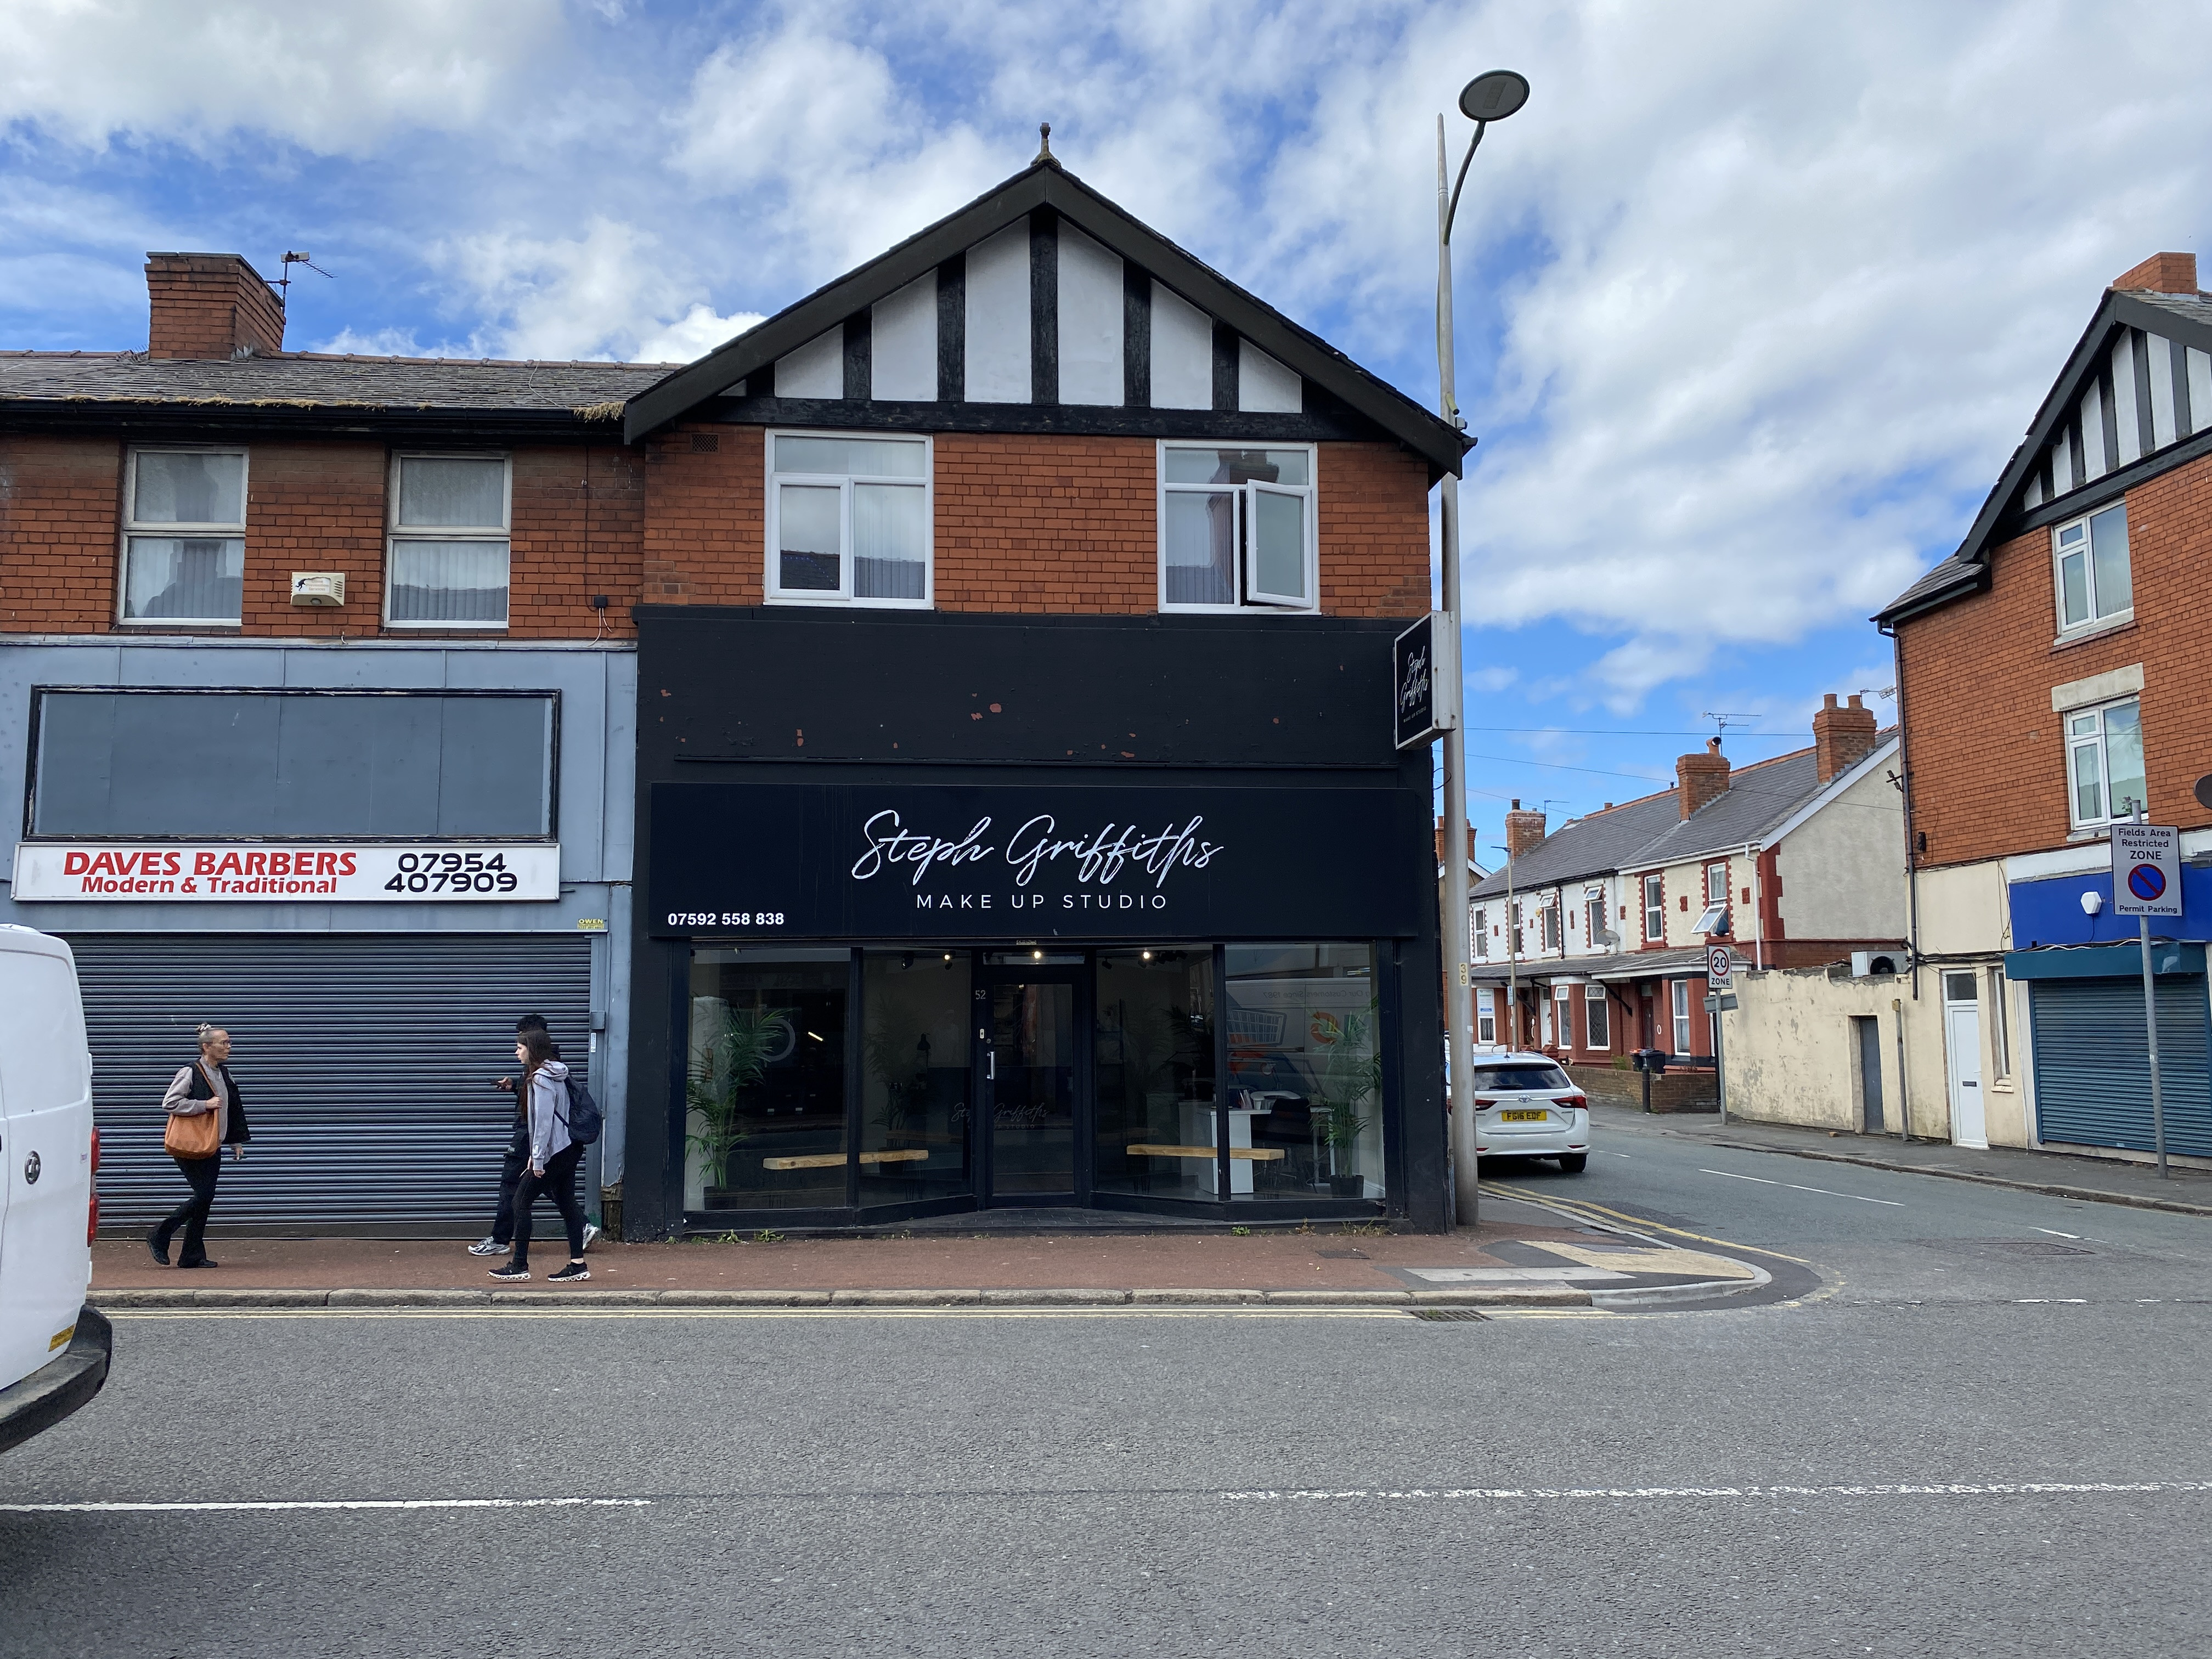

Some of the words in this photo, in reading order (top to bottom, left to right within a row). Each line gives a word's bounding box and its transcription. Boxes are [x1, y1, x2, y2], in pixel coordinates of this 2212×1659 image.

[1407, 645, 1426, 683] Steph
[1400, 668, 1429, 713] Griffiths
[2149, 829, 2171, 837] Area
[852, 810, 995, 887] Steph
[1006, 815, 1224, 887] Griffiths
[2122, 839, 2169, 848] Restricted
[398, 853, 507, 873] 07954
[2130, 850, 2163, 860] ZONE
[64, 853, 180, 876] DAVES
[194, 853, 357, 876] BARBERS
[82, 877, 174, 893] Modern
[182, 878, 197, 894] &
[209, 877, 337, 894] Traditional
[384, 873, 518, 893] 407909
[917, 895, 992, 909] MAKE
[1012, 895, 1045, 909] UP
[1063, 894, 1166, 910] STUDIO
[2148, 906, 2177, 914] Parking
[668, 913, 716, 926] 07592
[721, 913, 751, 926] 558
[755, 913, 785, 926] 838
[1713, 957, 1727, 968] 20
[975, 990, 986, 1000] 52
